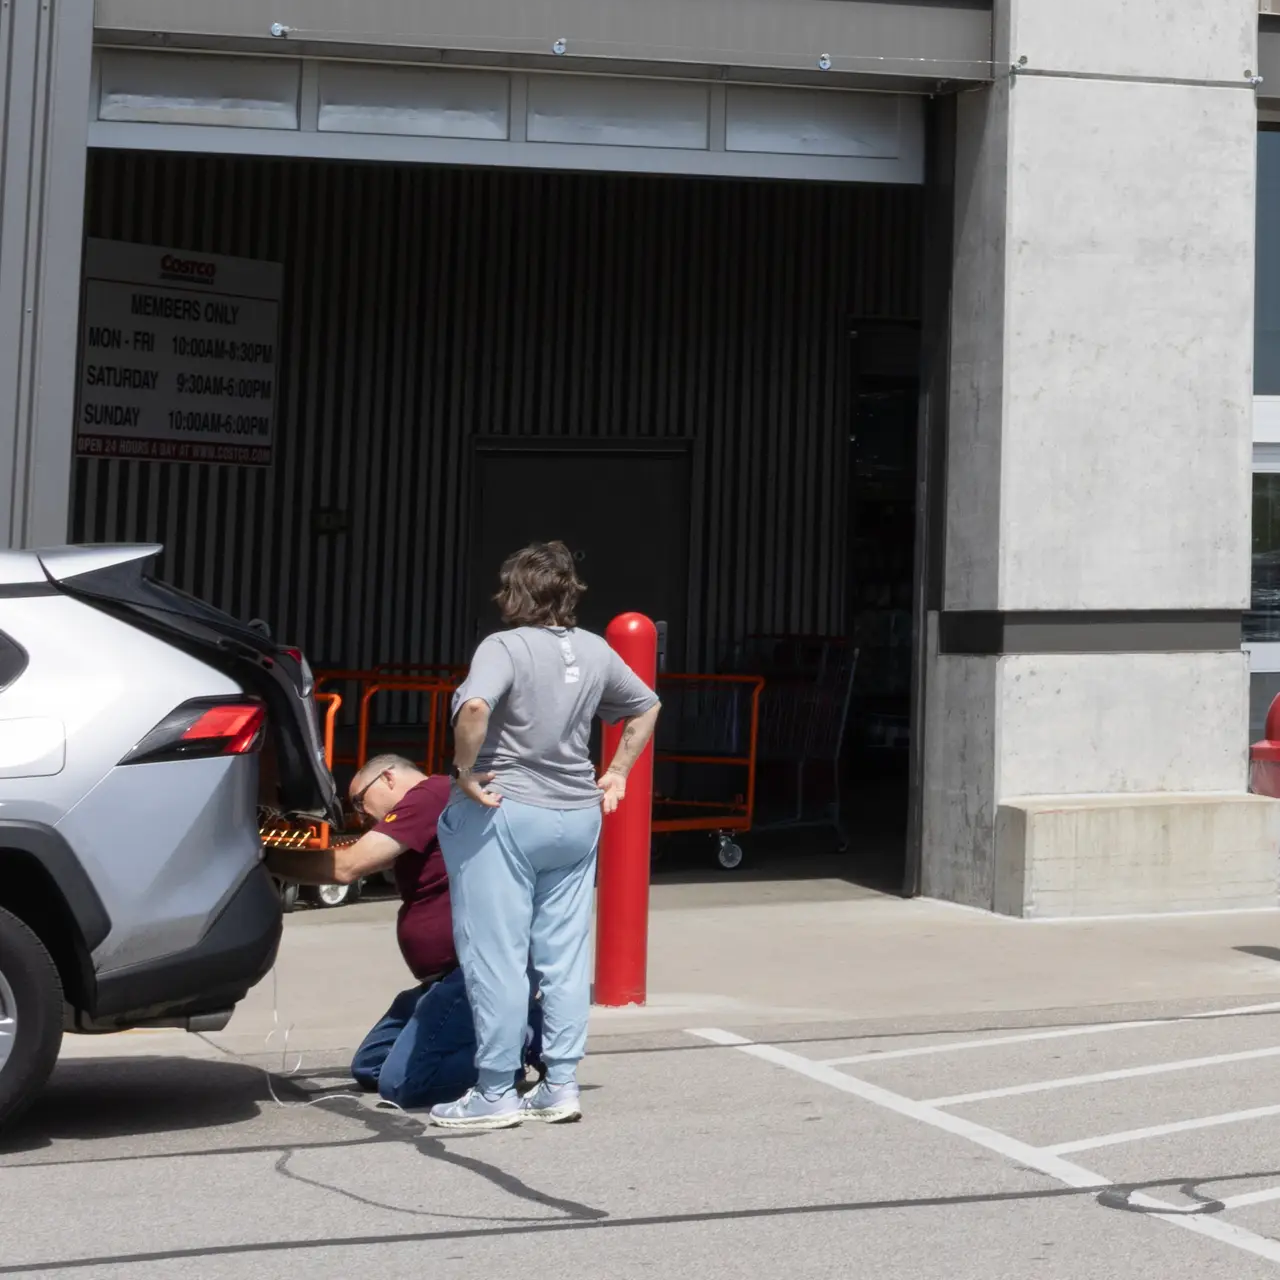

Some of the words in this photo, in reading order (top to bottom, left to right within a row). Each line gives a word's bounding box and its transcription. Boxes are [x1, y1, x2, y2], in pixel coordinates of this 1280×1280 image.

[161, 254, 216, 277] COSTCO
[131, 293, 201, 321] MEMBERS
[204, 302, 240, 325] ONLY
[88, 326, 122, 350] MON
[133, 331, 155, 352] FRI
[172, 334, 273, 363] 10:00AM-8:30PM
[86, 365, 159, 390] SATURDAY
[176, 372, 272, 400] 9:30AM-6:00PM
[84, 403, 141, 428] SUNDAY
[168, 410, 269, 436] 10:00AM-6:00PM
